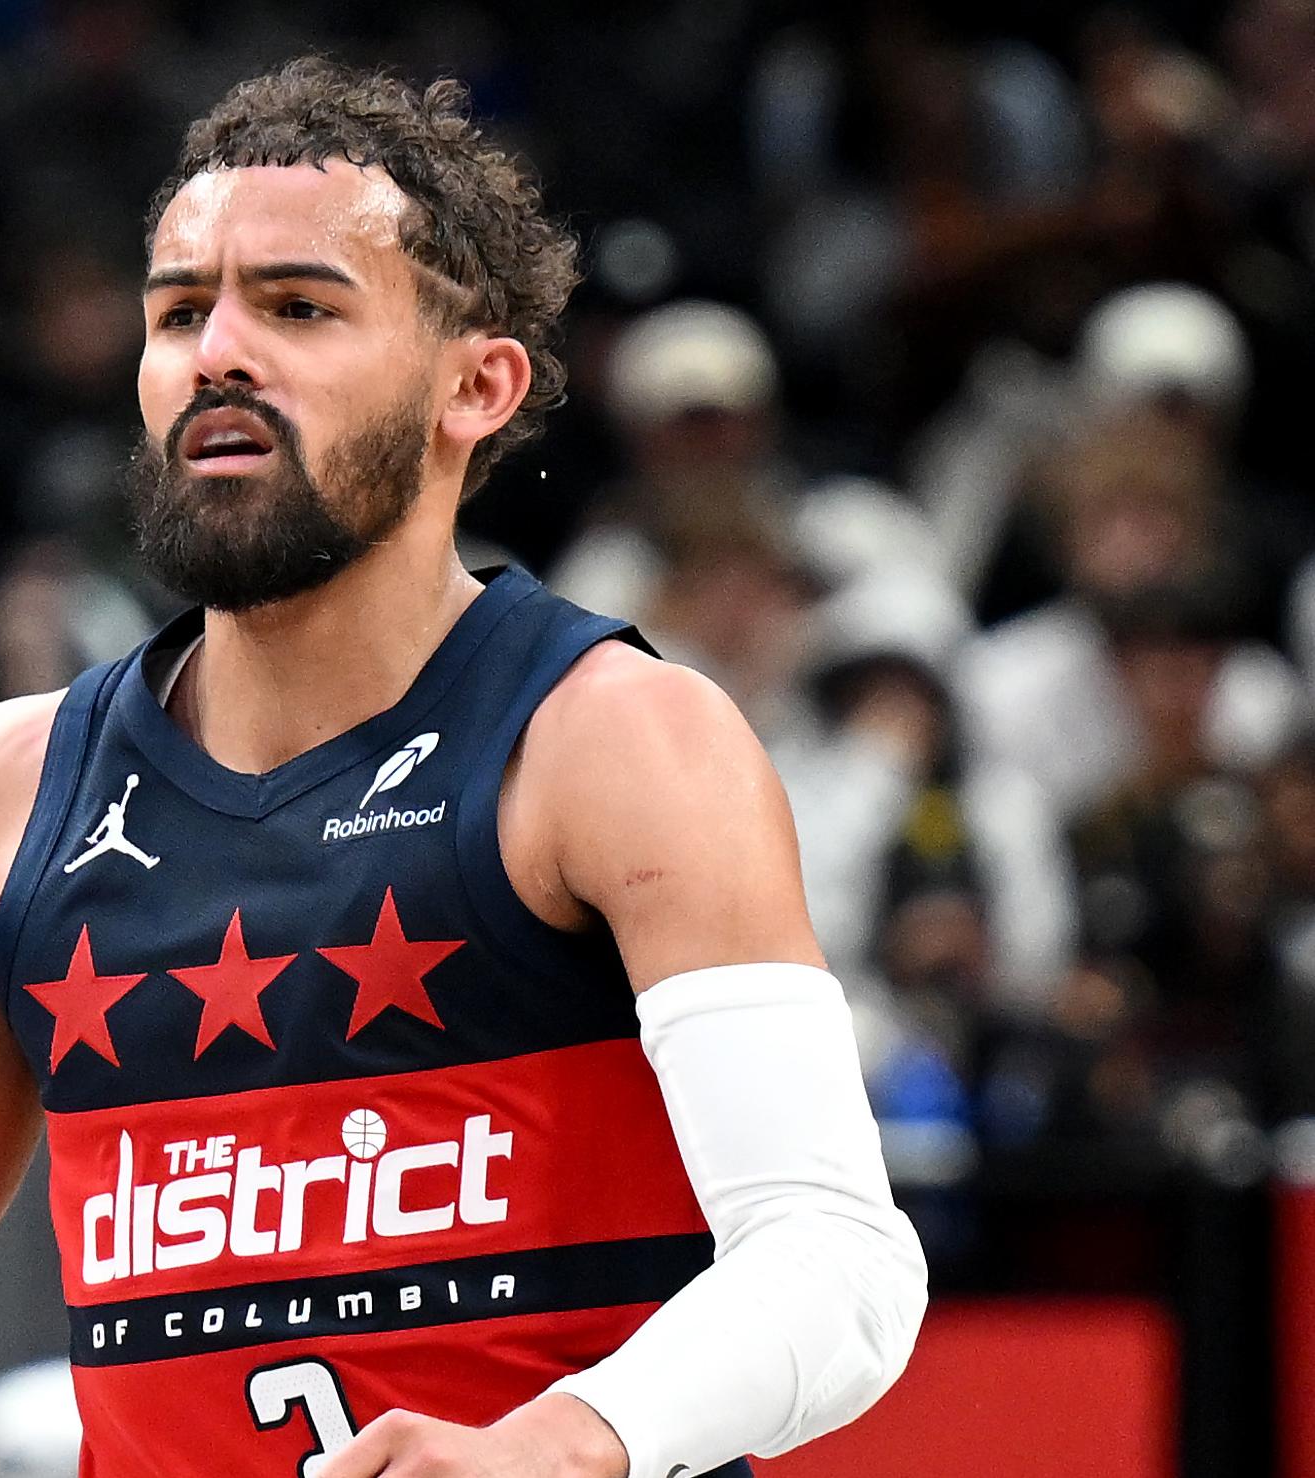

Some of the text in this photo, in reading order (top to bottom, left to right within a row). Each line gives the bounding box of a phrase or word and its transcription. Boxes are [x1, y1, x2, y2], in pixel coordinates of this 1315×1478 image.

[322, 800, 446, 841] Robinhood
[163, 1135, 236, 1175] THE
[83, 1108, 513, 1285] district
[92, 1274, 515, 1349] OF COLUMBIA
